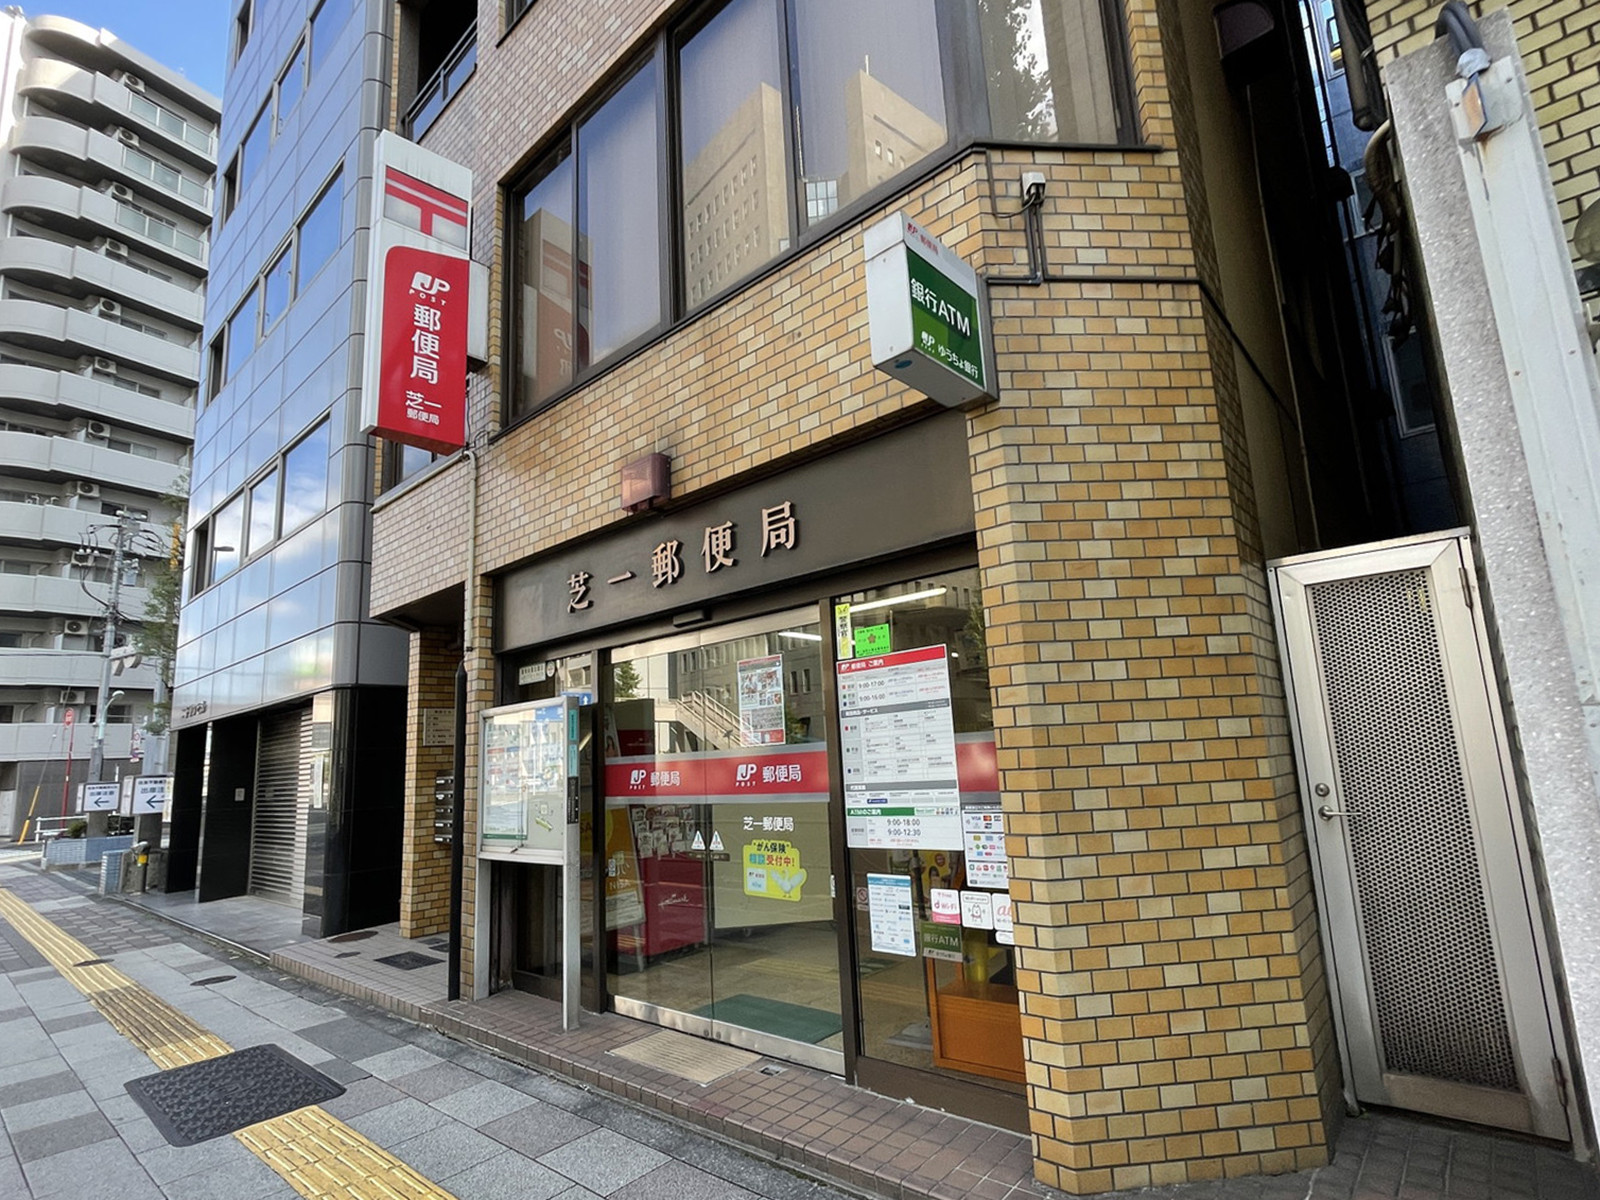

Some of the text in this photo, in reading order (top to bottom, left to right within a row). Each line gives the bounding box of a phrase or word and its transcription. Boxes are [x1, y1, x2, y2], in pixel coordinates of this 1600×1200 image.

[911, 277, 970, 337] 銀行ATM
[410, 303, 441, 384] 郵便局
[937, 344, 979, 379] ゆうちょ銀行
[405, 390, 442, 410] 芝一
[566, 500, 796, 613] 芝一郵便局
[650, 771, 681, 787] 郵便局
[762, 764, 802, 783] 郵便局
[743, 816, 795, 832] 芝一郵便局
